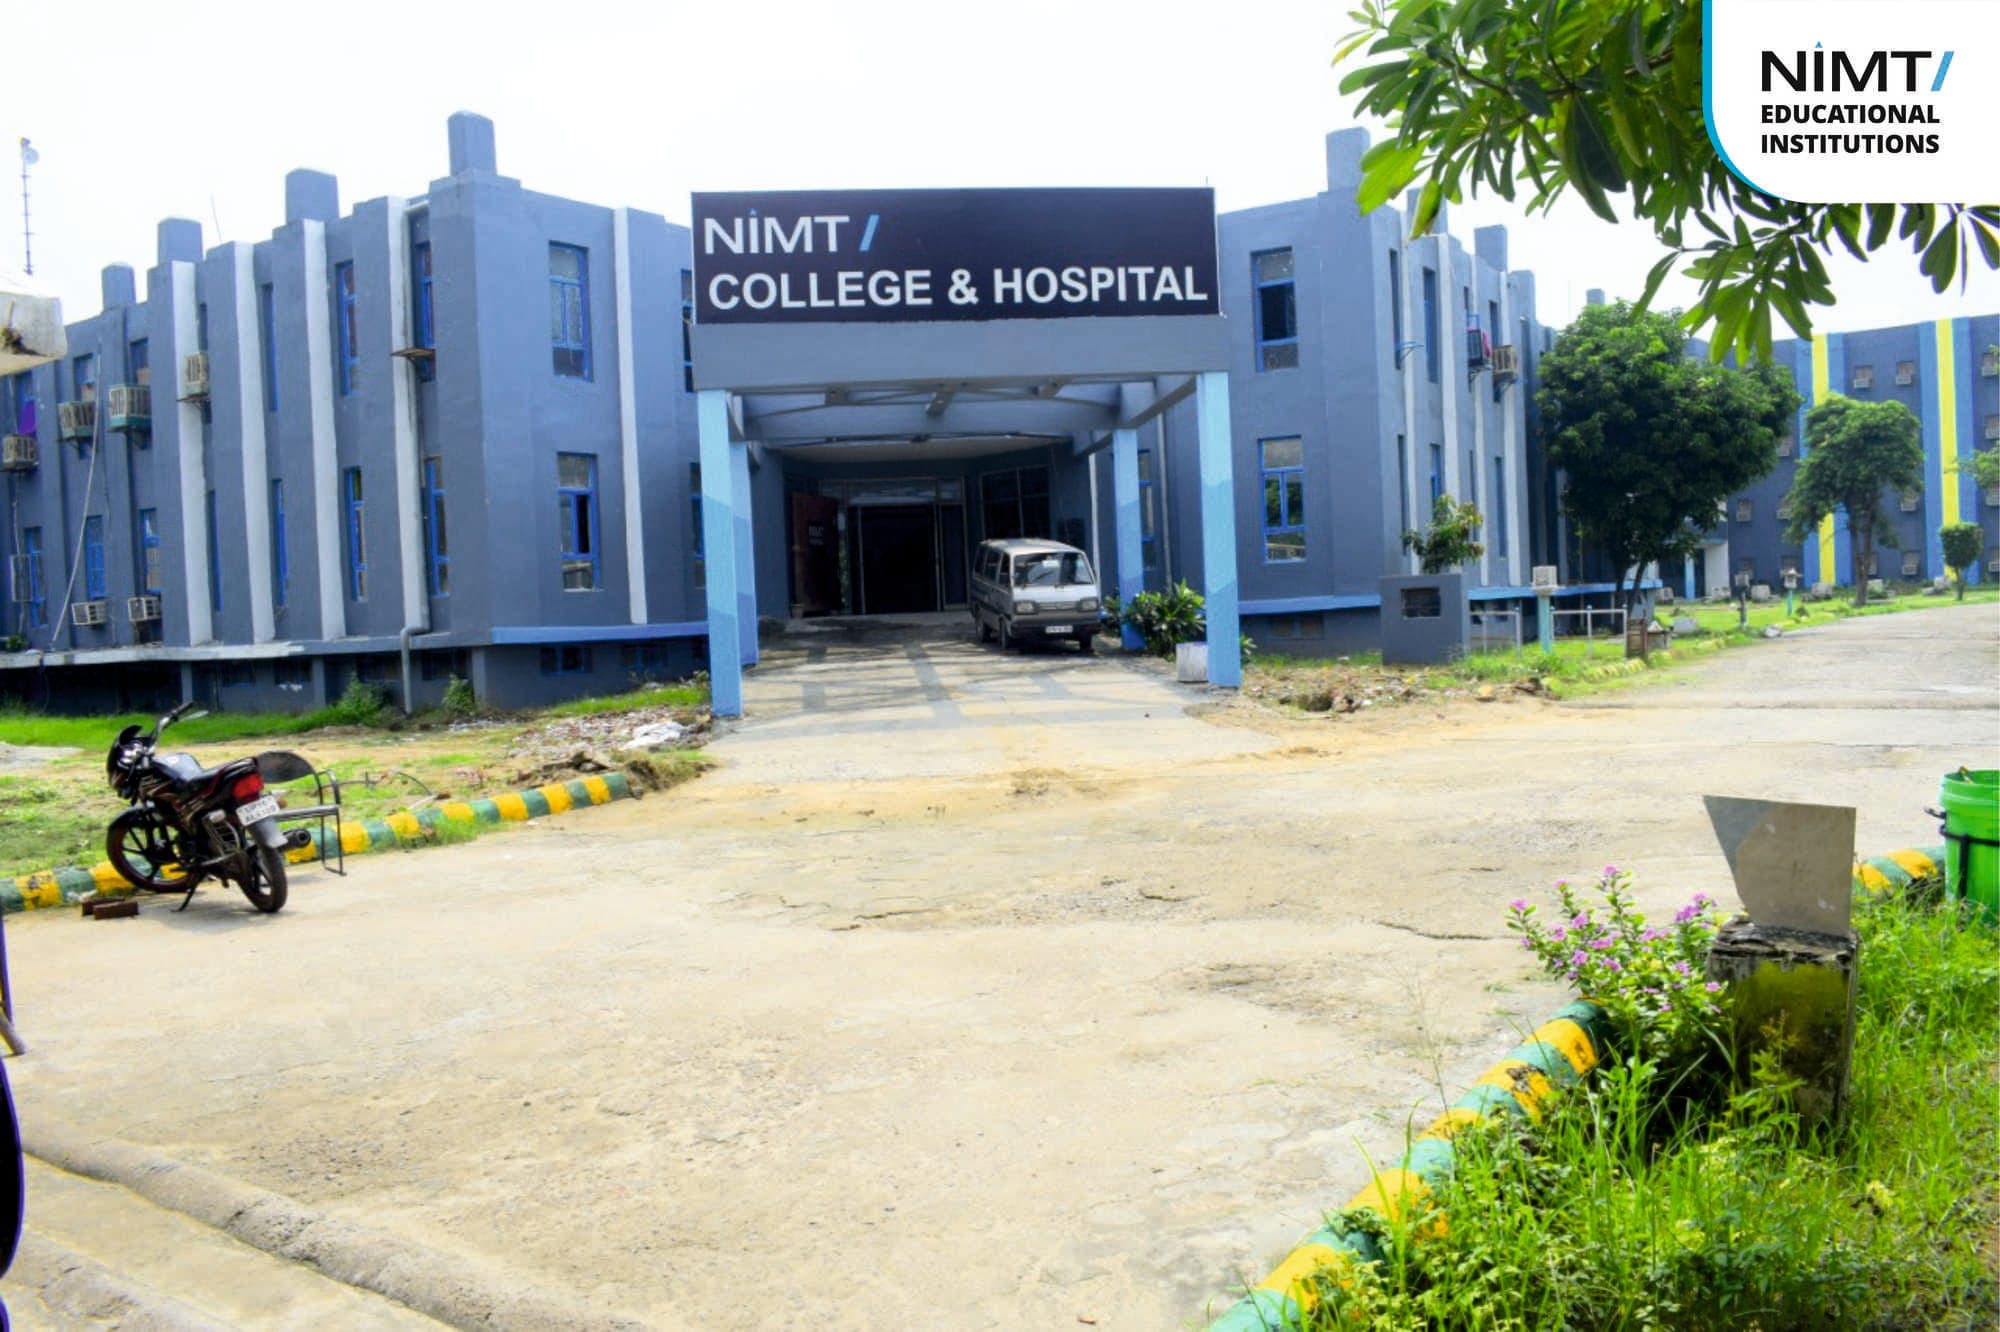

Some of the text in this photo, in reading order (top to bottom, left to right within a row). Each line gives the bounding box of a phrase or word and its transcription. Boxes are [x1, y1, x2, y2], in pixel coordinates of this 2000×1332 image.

[709, 265, 1207, 310] COLLEGE & HOSPITAL
